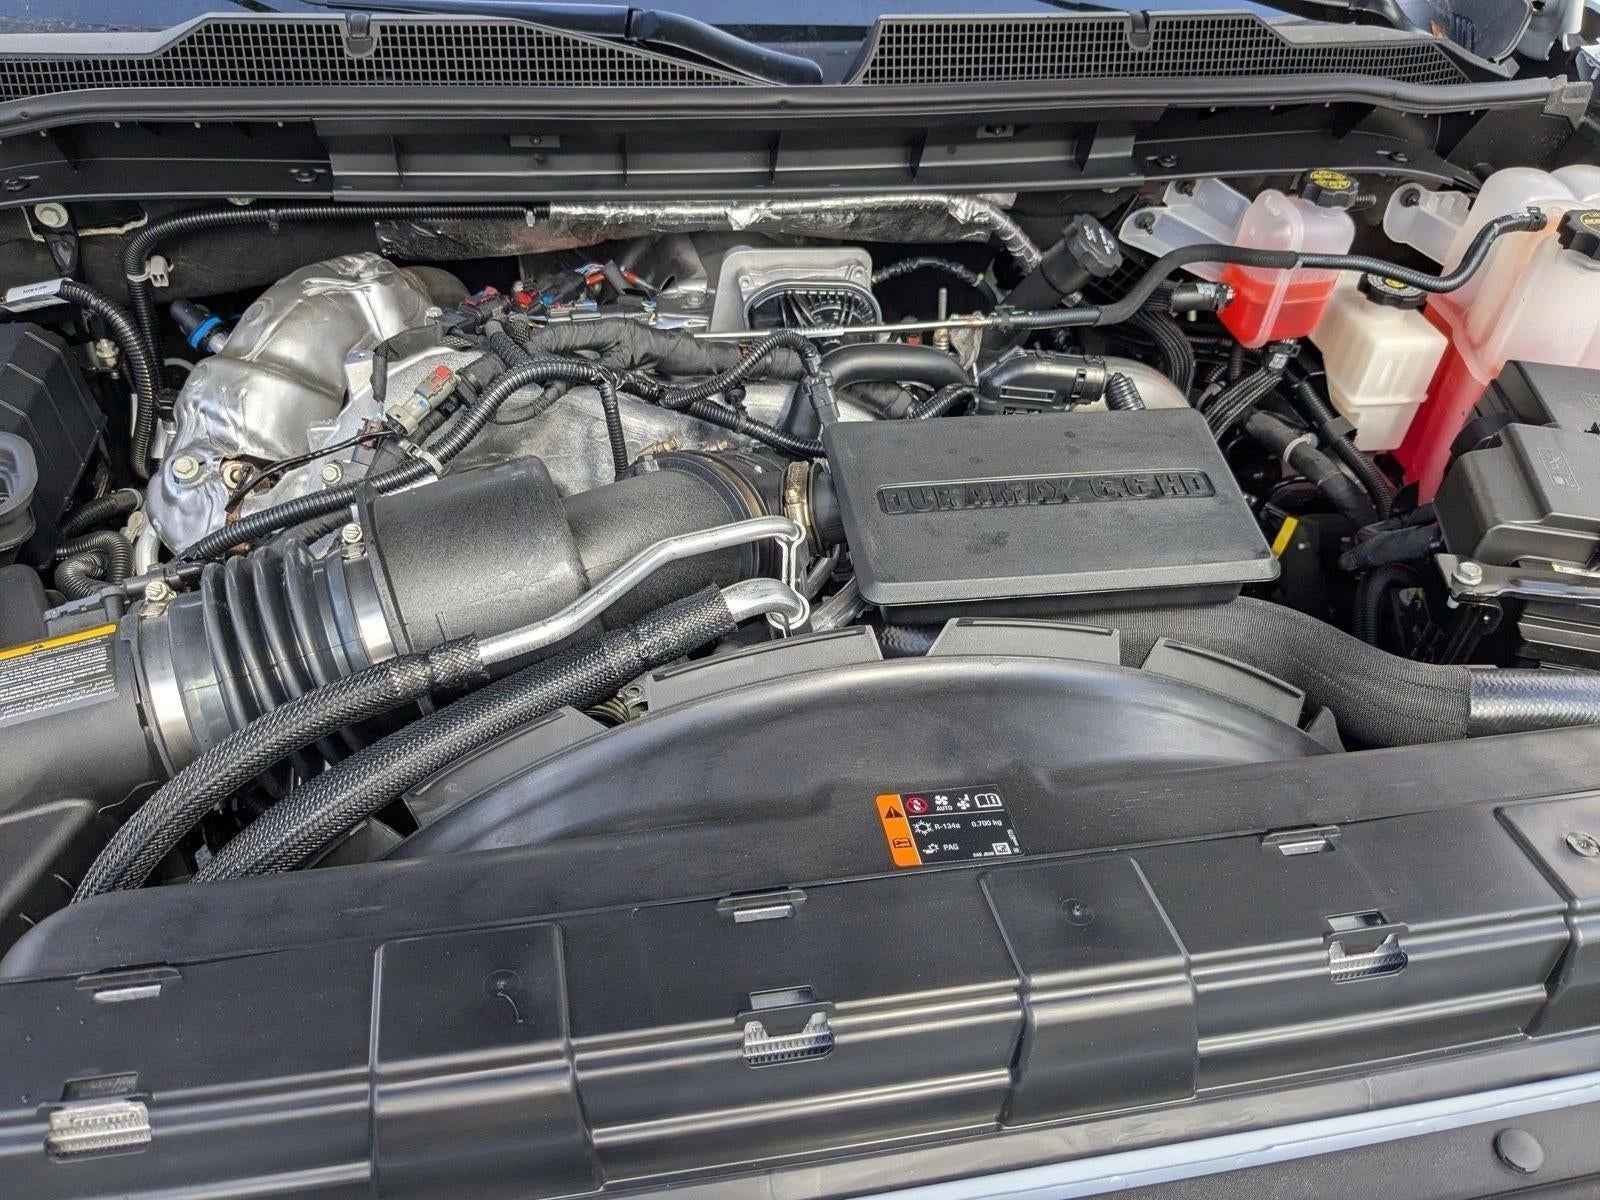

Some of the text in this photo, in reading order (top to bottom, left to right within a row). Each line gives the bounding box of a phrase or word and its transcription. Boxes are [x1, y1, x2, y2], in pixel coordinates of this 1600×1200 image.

[881, 473, 1208, 513] DURAMAX 6.6 HD
[934, 819, 1003, 830] R-134a 0.700 kg
[943, 843, 959, 851] PAG
